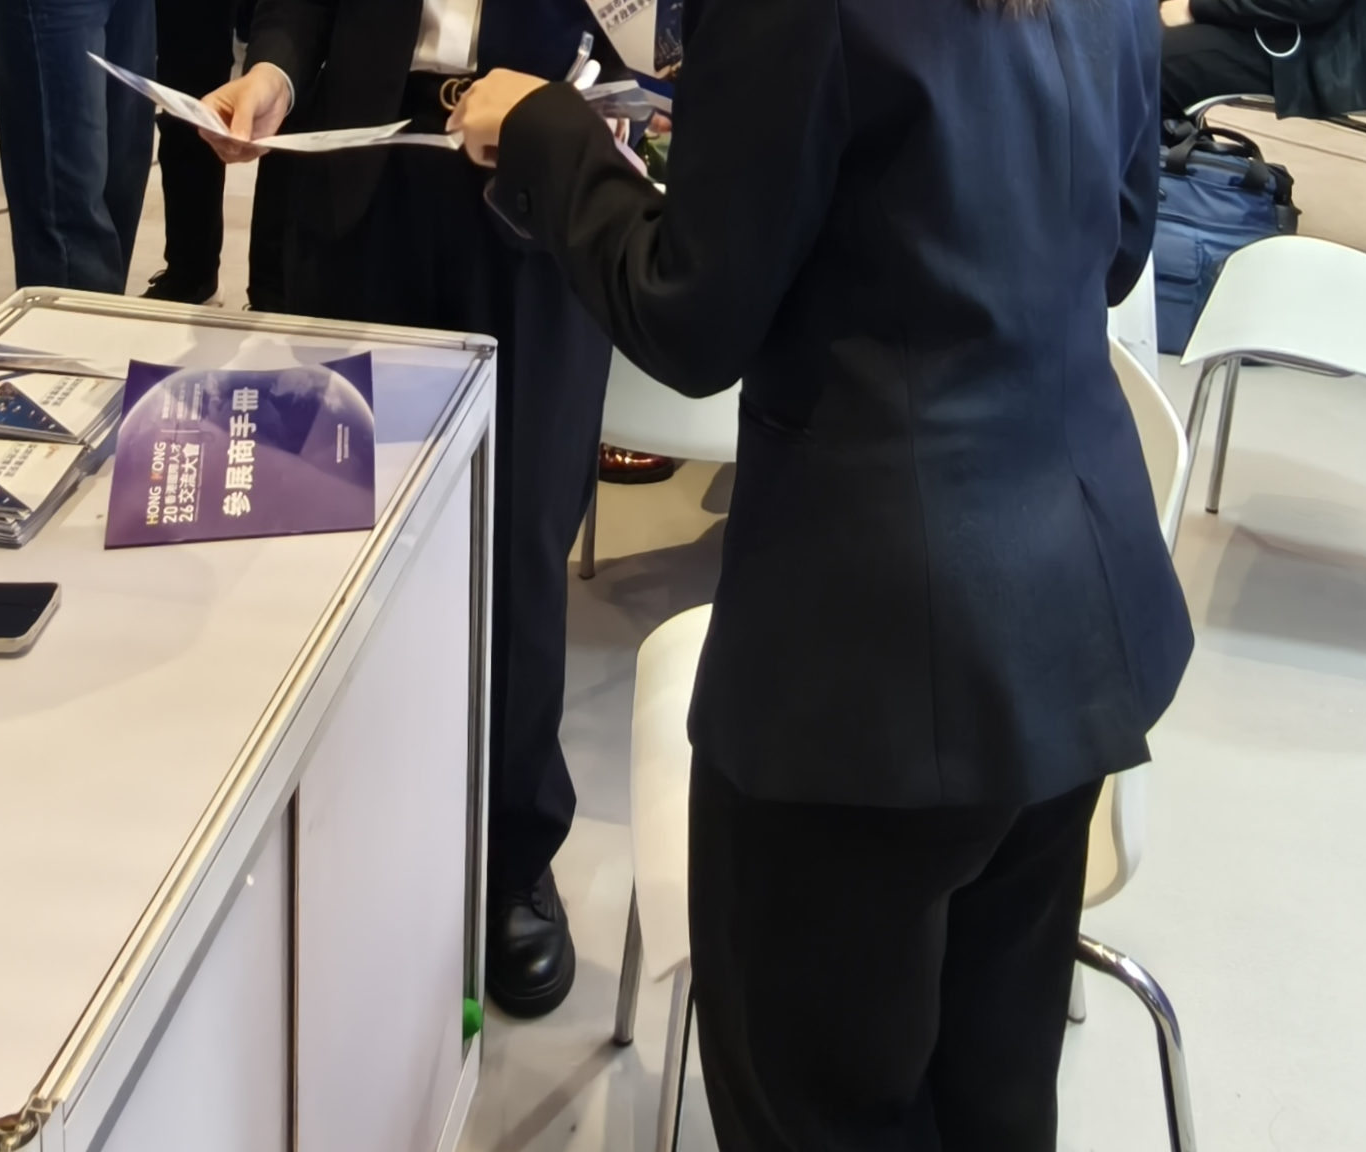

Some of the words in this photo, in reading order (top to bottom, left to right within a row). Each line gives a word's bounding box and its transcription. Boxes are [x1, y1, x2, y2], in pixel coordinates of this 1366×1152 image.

[150, 441, 166, 481] KONG
[223, 387, 259, 517] 參展商手冊
[164, 442, 182, 505] 香港國際人才
[178, 442, 200, 504] 交流大會
[146, 485, 162, 525] HONG
[163, 505, 179, 524] 20
[178, 504, 195, 524] 26
